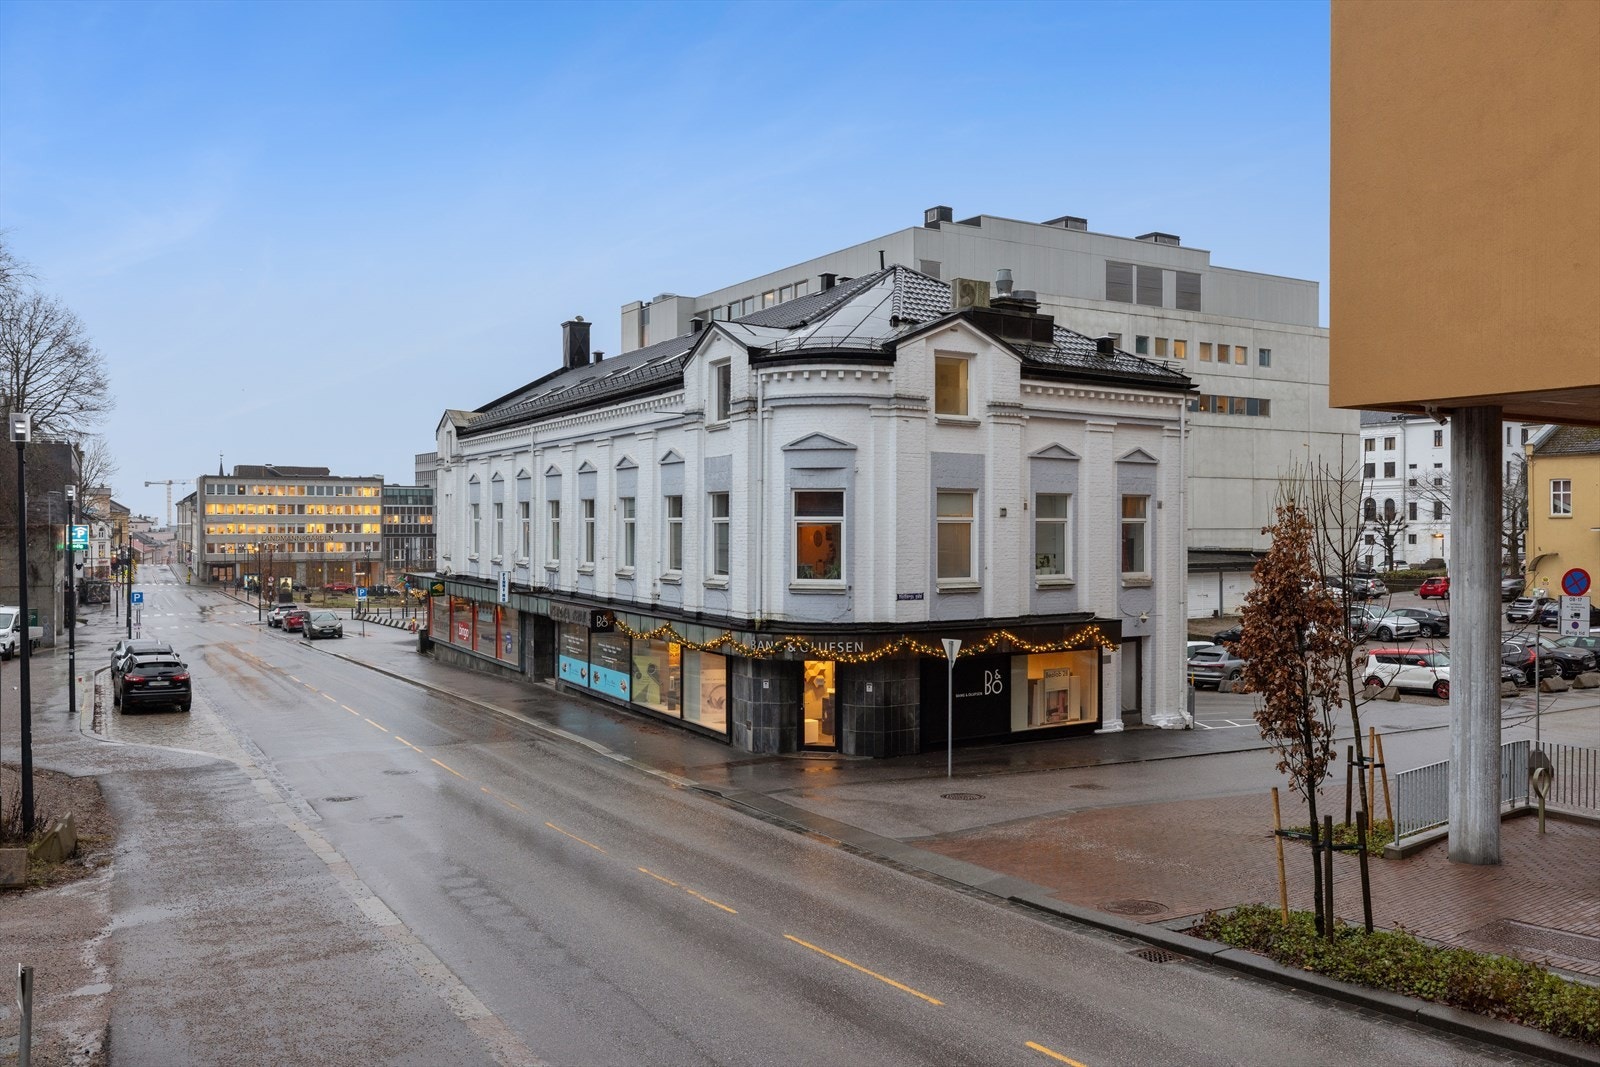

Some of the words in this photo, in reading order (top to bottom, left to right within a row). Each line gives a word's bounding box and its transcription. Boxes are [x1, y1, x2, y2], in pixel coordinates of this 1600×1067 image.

[134, 594, 140, 602] P
[750, 640, 782, 652] BAN
[788, 642, 796, 652] &
